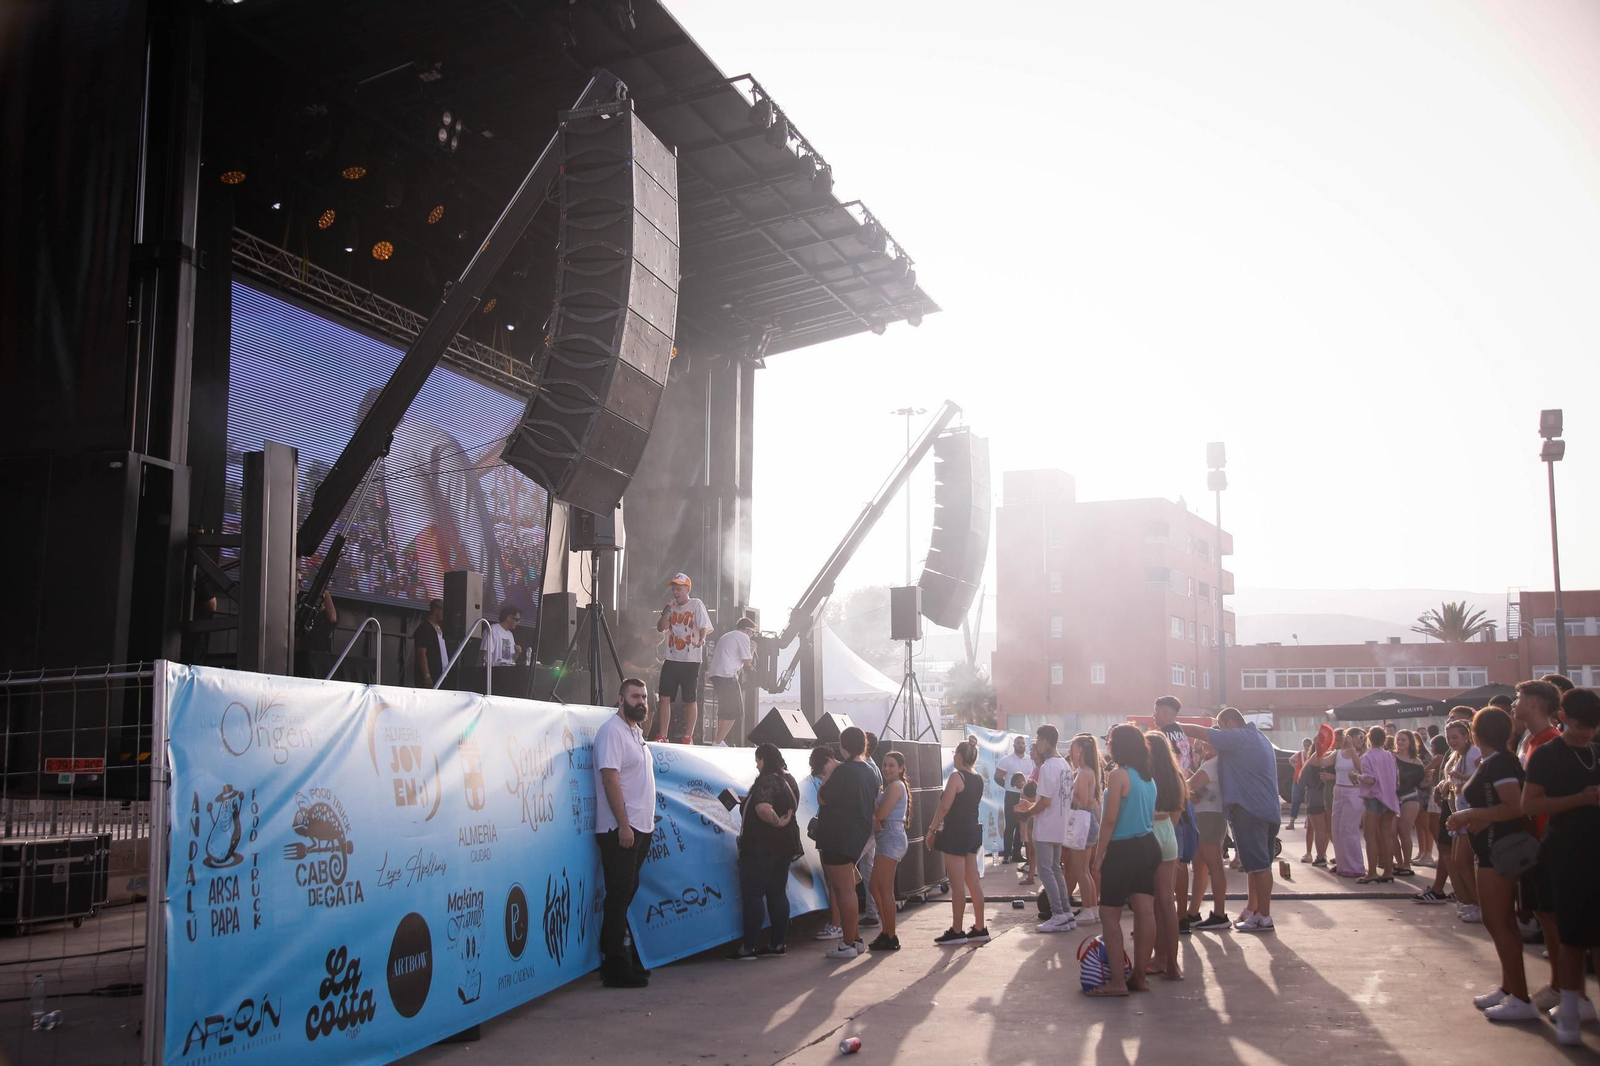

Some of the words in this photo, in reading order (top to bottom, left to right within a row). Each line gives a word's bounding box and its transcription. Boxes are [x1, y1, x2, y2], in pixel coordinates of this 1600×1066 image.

[1397, 706, 1424, 714] CHOUFFE
[220, 700, 313, 765] Origen
[390, 744, 423, 773] JOV
[506, 730, 555, 795] South
[686, 780, 703, 788] FOOD
[250, 788, 259, 842] FOOD
[309, 787, 332, 801] FOOD
[333, 795, 352, 835] TRUCK
[520, 774, 554, 832] Kids
[458, 819, 498, 847] ALMERÍA
[470, 848, 492, 863] CIUDAD
[646, 842, 671, 863] PAPA
[295, 853, 347, 887] CABO
[208, 874, 241, 906] ARSA
[251, 852, 261, 930] TRUCK
[446, 886, 484, 914] Making
[210, 906, 240, 937] PAPA
[319, 944, 363, 1001] La
[391, 950, 429, 978] ARTBOW
[305, 988, 377, 1042] costa
